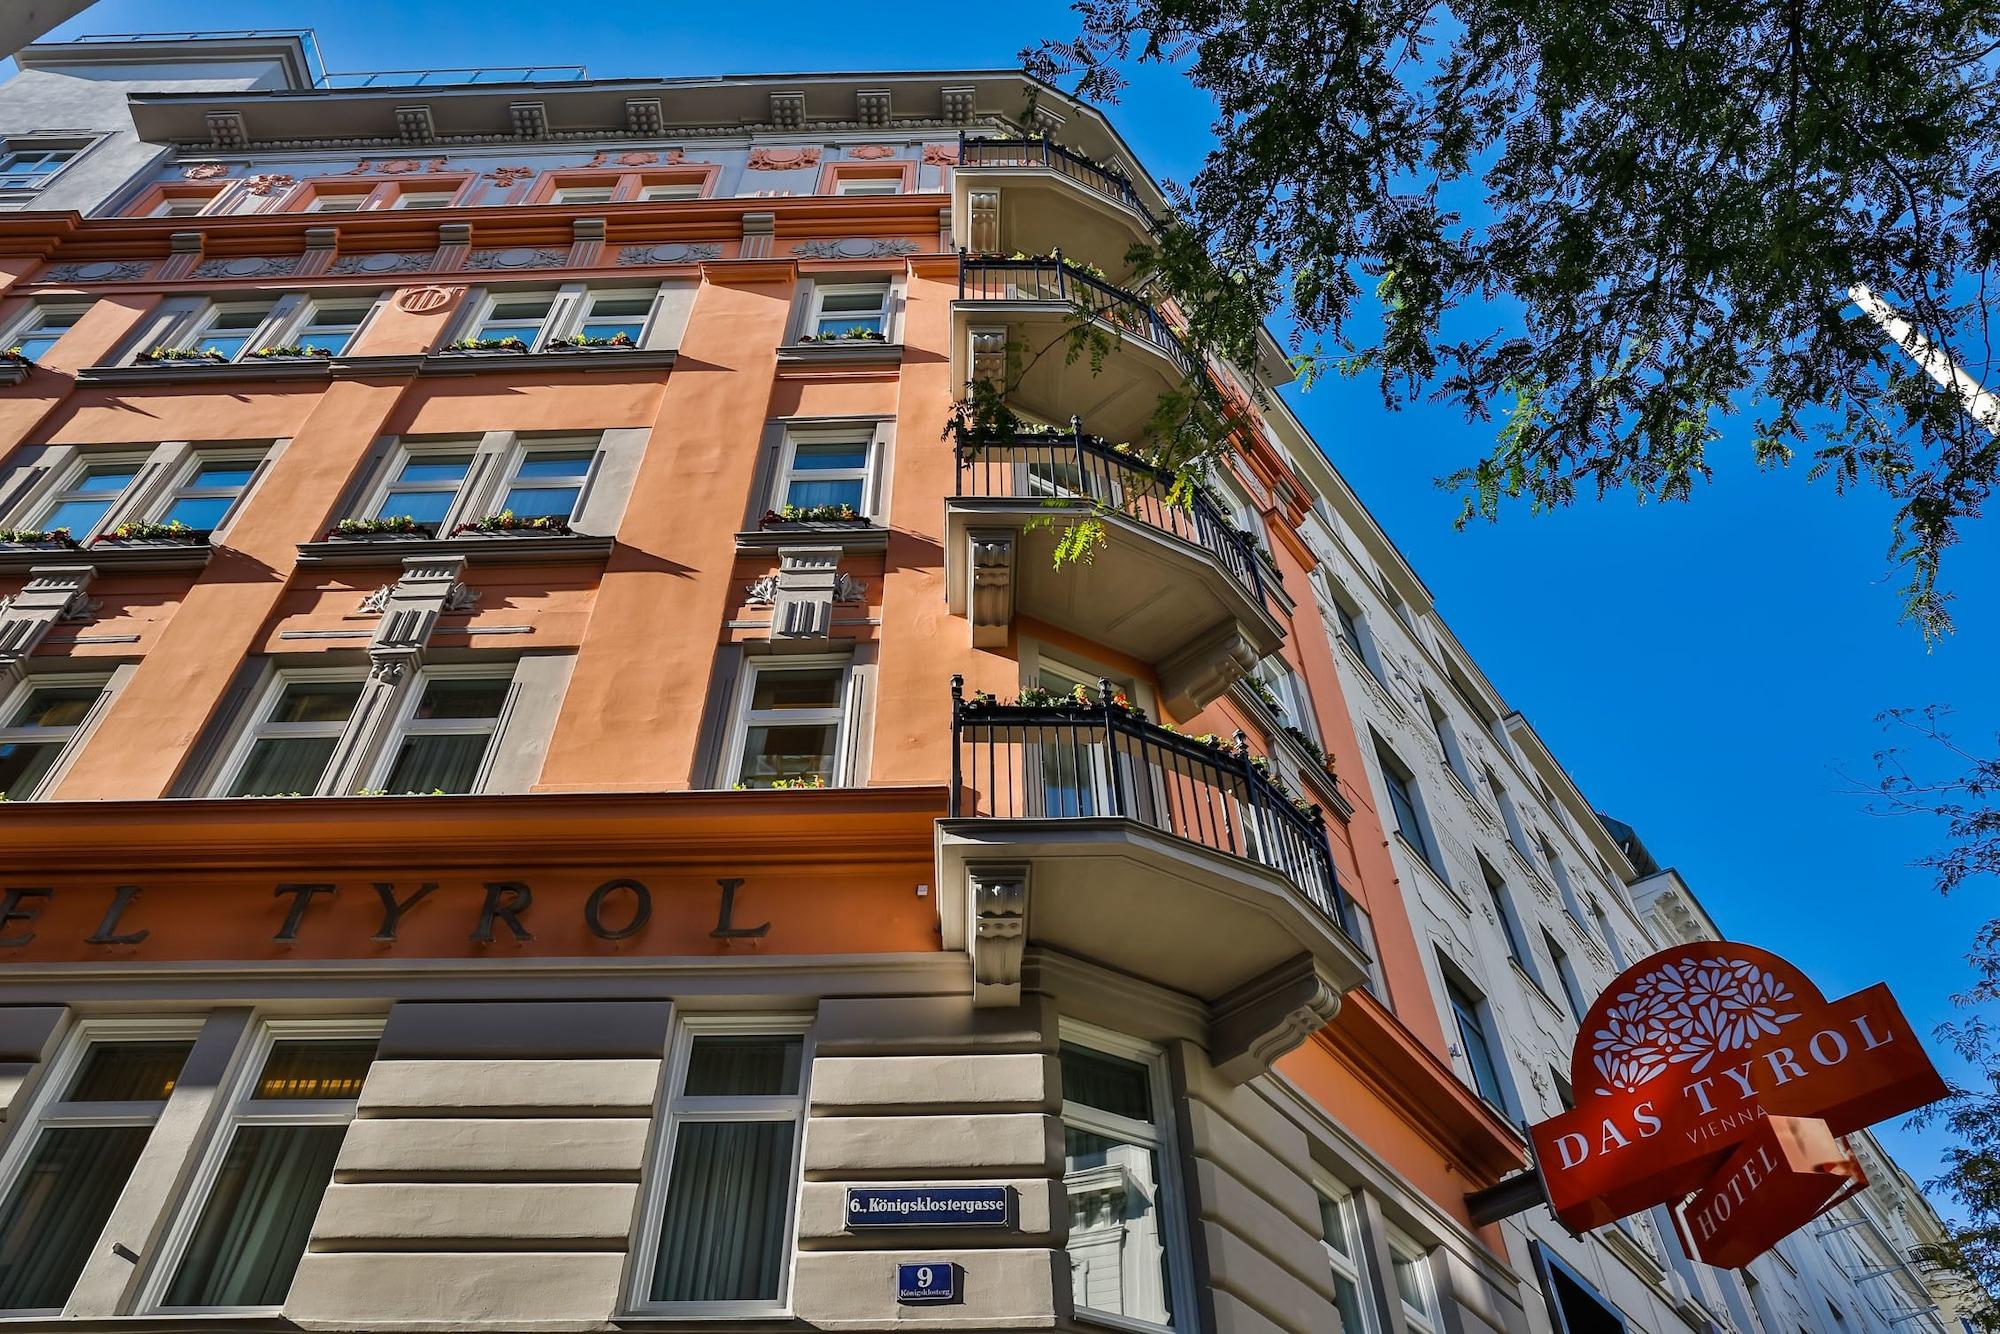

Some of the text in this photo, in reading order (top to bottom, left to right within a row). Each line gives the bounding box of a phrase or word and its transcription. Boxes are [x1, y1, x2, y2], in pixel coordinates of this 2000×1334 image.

[274, 878, 771, 942] TYROL
[1553, 1014, 1893, 1170] DAS TYROL
[1686, 1104, 1770, 1144] VIENNA
[869, 1197, 1004, 1214] Königsklostergasse
[1697, 1147, 1778, 1242] HOTEL
[917, 1267, 933, 1288] 9
